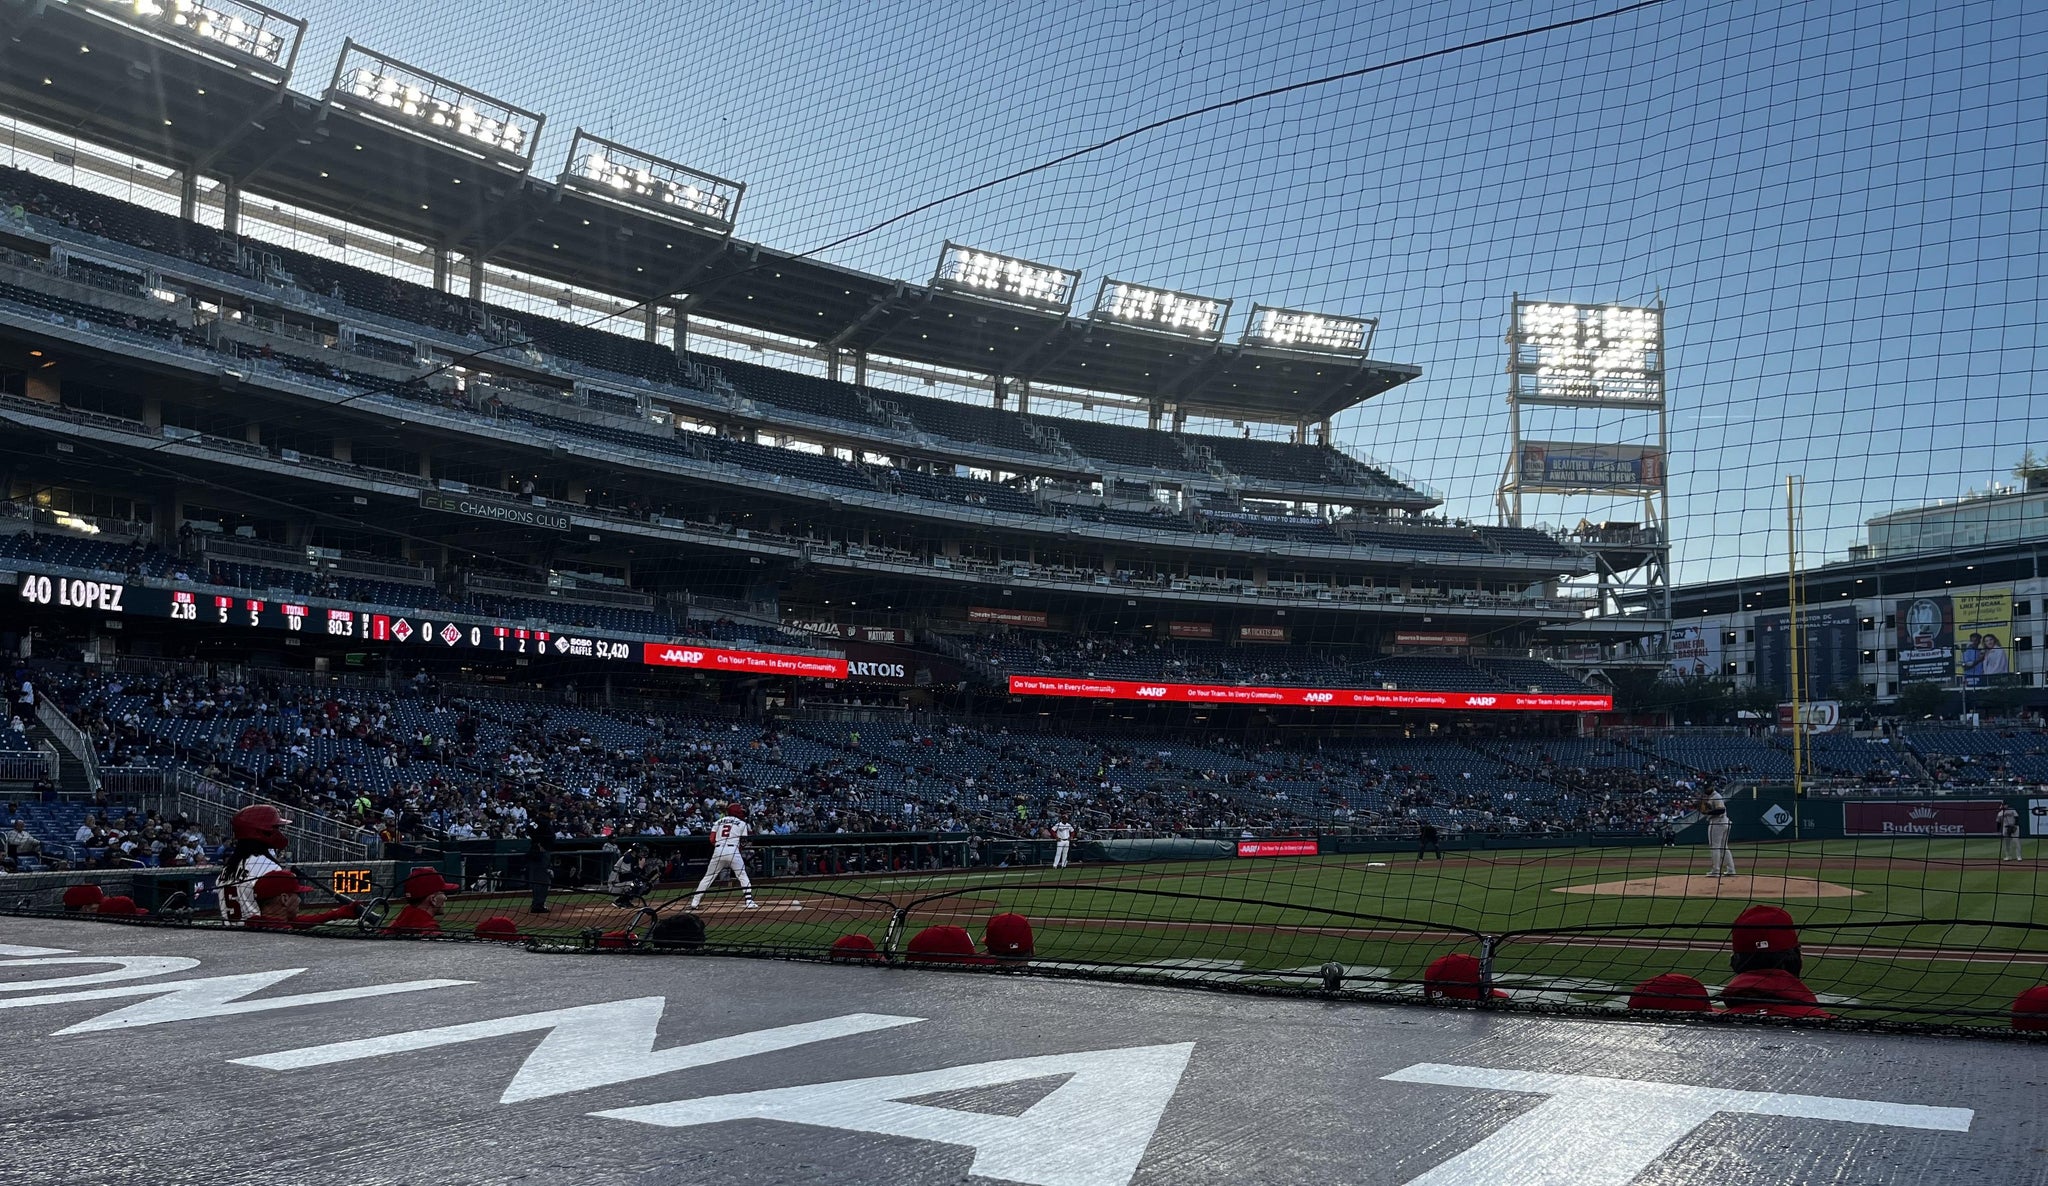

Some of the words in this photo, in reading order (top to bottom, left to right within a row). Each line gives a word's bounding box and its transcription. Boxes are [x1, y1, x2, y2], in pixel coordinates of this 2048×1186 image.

[1617, 462, 1632, 472] AND
[1577, 471, 1609, 482] WINNING
[460, 502, 533, 524] CHAMPIONS
[536, 514, 567, 529] CLUB
[22, 574, 52, 604] 40
[59, 578, 124, 612] LOPEZ
[170, 602, 197, 620] 2.18
[219, 607, 228, 624] 5
[286, 606, 305, 616] TOTAL
[330, 611, 350, 621] SPEED
[250, 611, 259, 627] 5
[288, 616, 302, 631] 10
[328, 620, 353, 636] 80.3
[422, 622, 433, 642] 0
[471, 627, 481, 646] 0
[499, 637, 504, 651] 1
[518, 639, 526, 653] 2
[538, 641, 546, 654] 0
[570, 645, 592, 657] RAFFLE
[596, 640, 630, 659] $2,420
[1673, 640, 1691, 650] HOME
[660, 649, 704, 664] AARP
[717, 655, 728, 663] On
[728, 656, 746, 664] Your
[746, 657, 768, 666] Team.
[769, 659, 776, 667] In
[777, 660, 796, 669] Every
[797, 661, 837, 673] Community.
[847, 660, 905, 678] ARTOIS
[1014, 680, 1023, 688] On
[1024, 681, 1037, 689] Your
[1038, 682, 1057, 690] Team.
[1064, 683, 1081, 692] Every
[1081, 684, 1116, 694] Community.
[1136, 686, 1167, 697] AARP
[1196, 689, 1209, 697] Your
[1303, 693, 1333, 703] AARP
[1353, 694, 1362, 702] On
[1399, 696, 1414, 704] Every
[1414, 696, 1447, 704] Community.
[1465, 697, 1497, 706] AARP
[721, 825, 732, 837] 2
[1882, 821, 1964, 833] Budweiser
